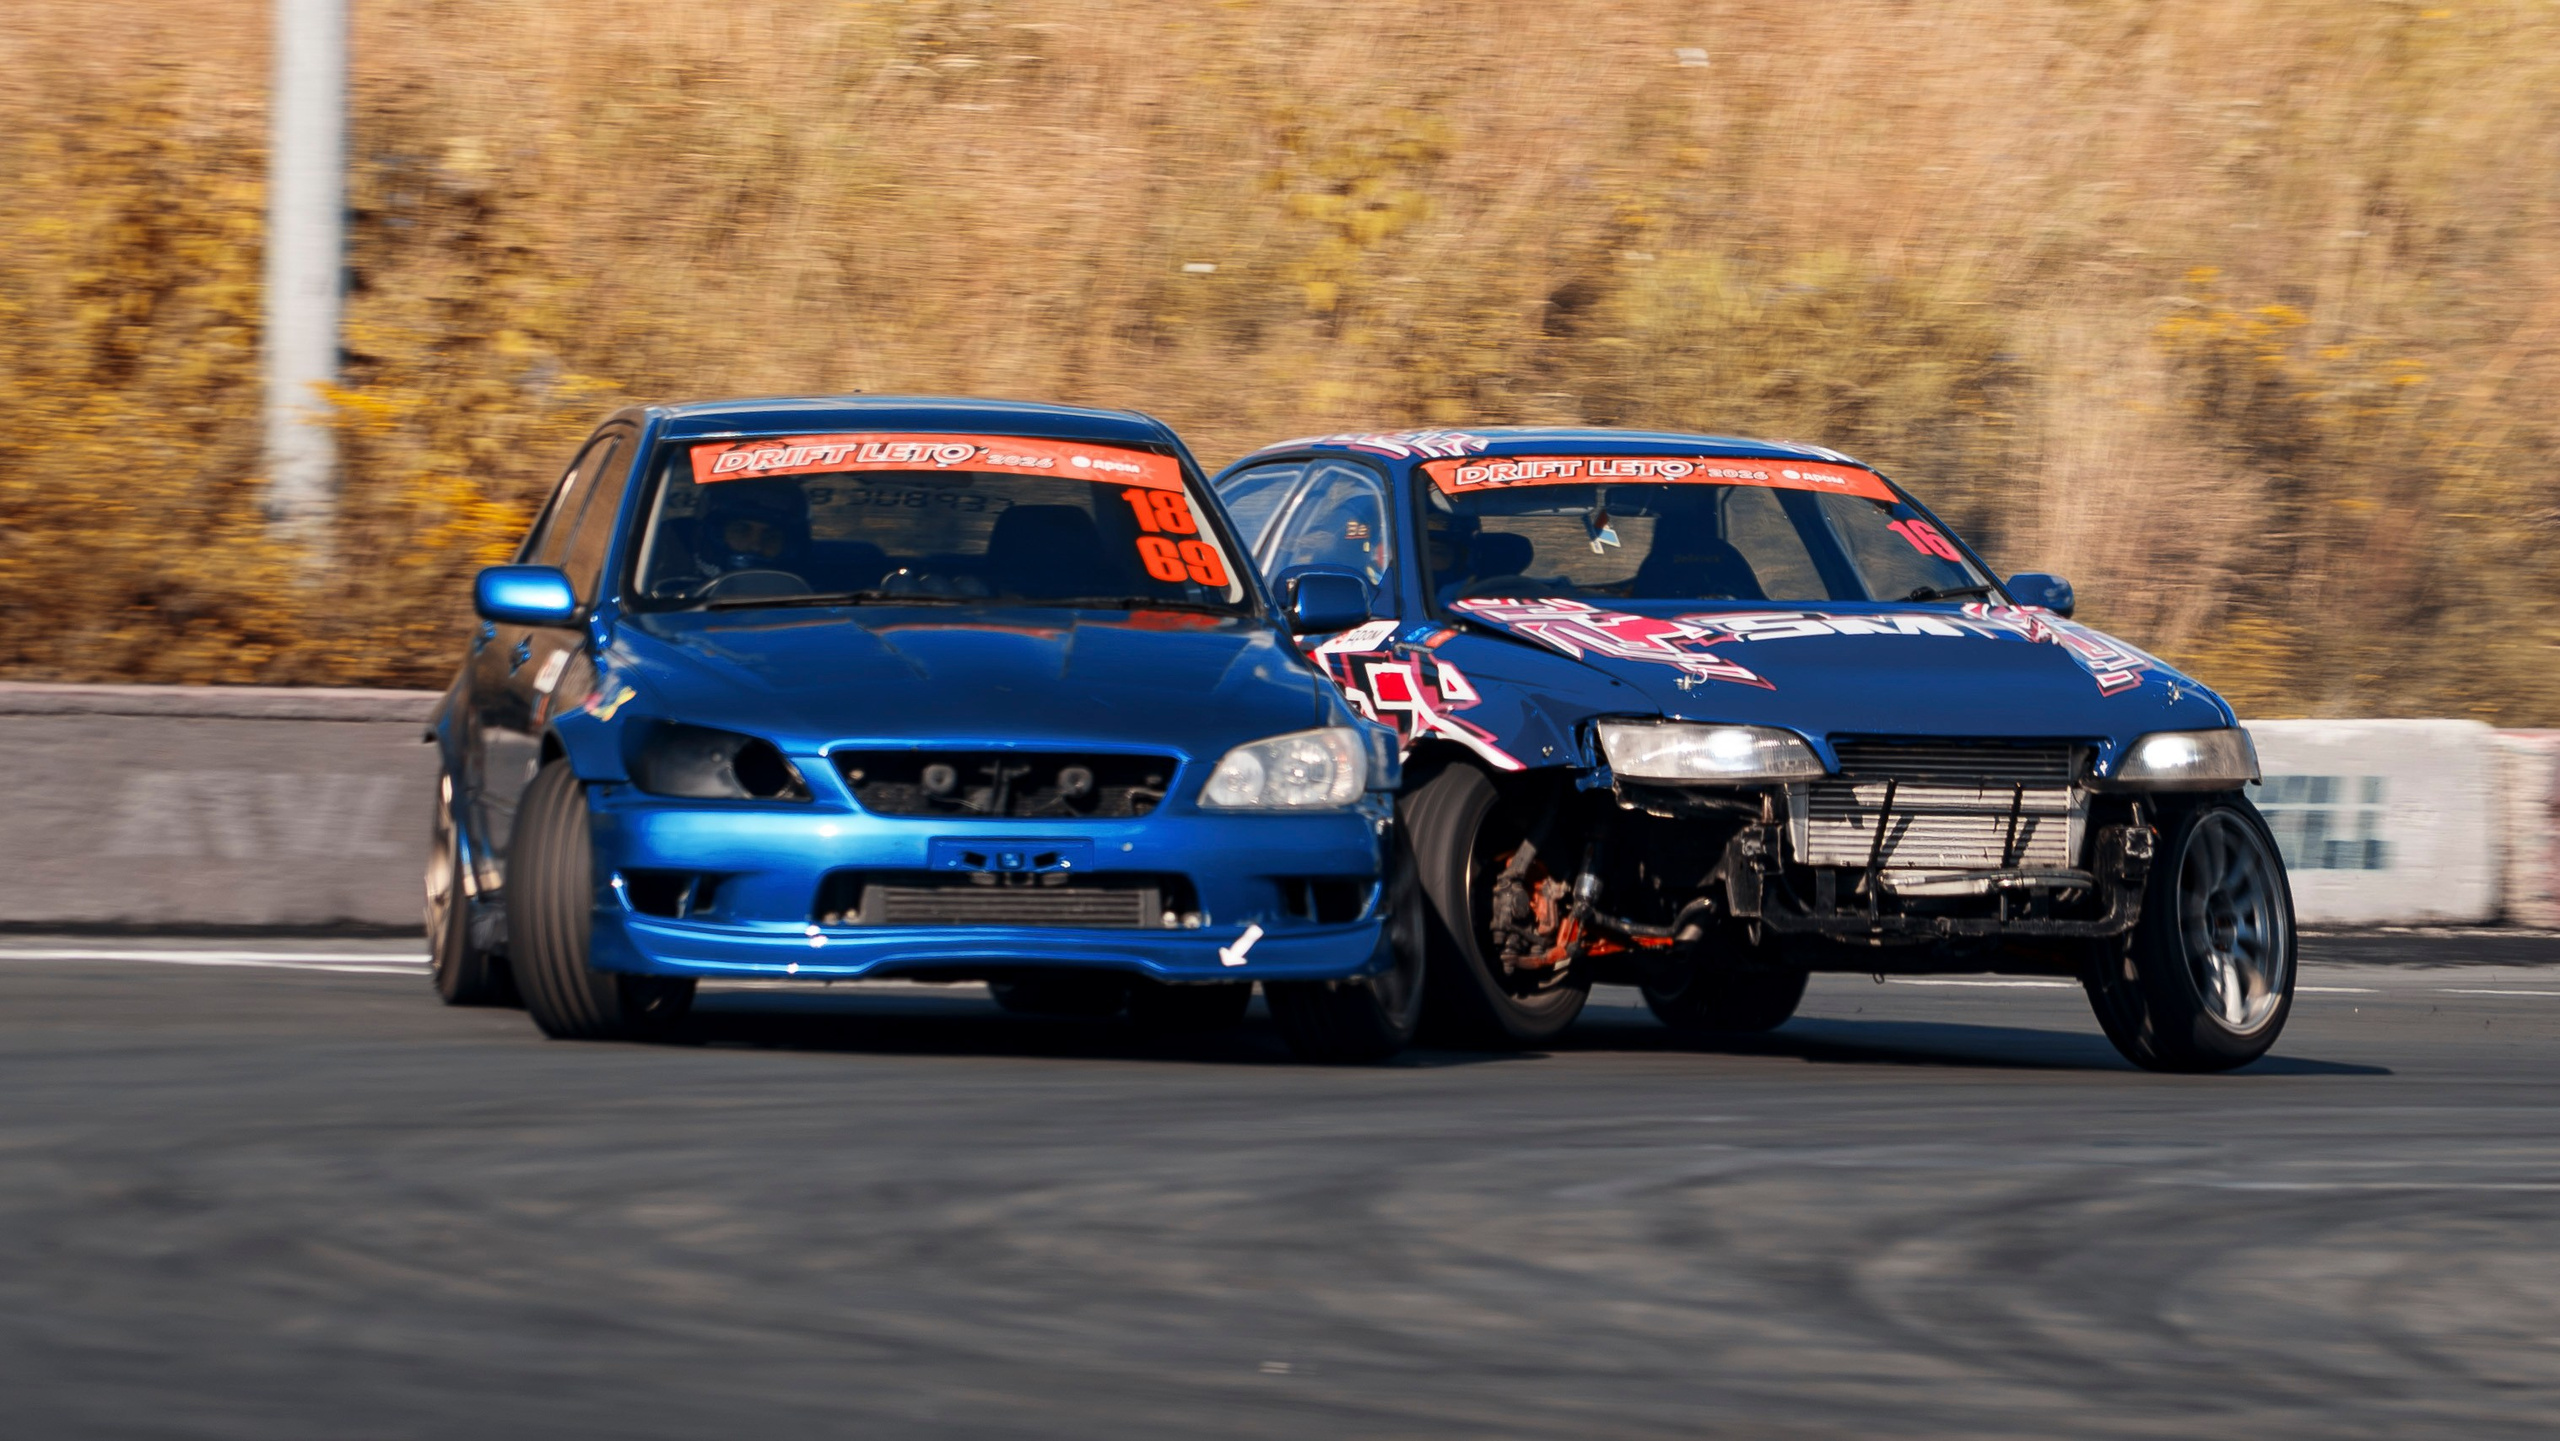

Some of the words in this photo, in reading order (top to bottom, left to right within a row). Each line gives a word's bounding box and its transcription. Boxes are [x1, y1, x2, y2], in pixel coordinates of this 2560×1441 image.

[712, 443, 854, 474] DRIFT
[856, 443, 976, 463] LETO
[1455, 460, 1582, 486] DRIFT
[1588, 459, 1694, 478] LETO
[1121, 488, 1198, 535] 18
[1136, 536, 1229, 587] 69
[1886, 519, 1961, 563] 16
